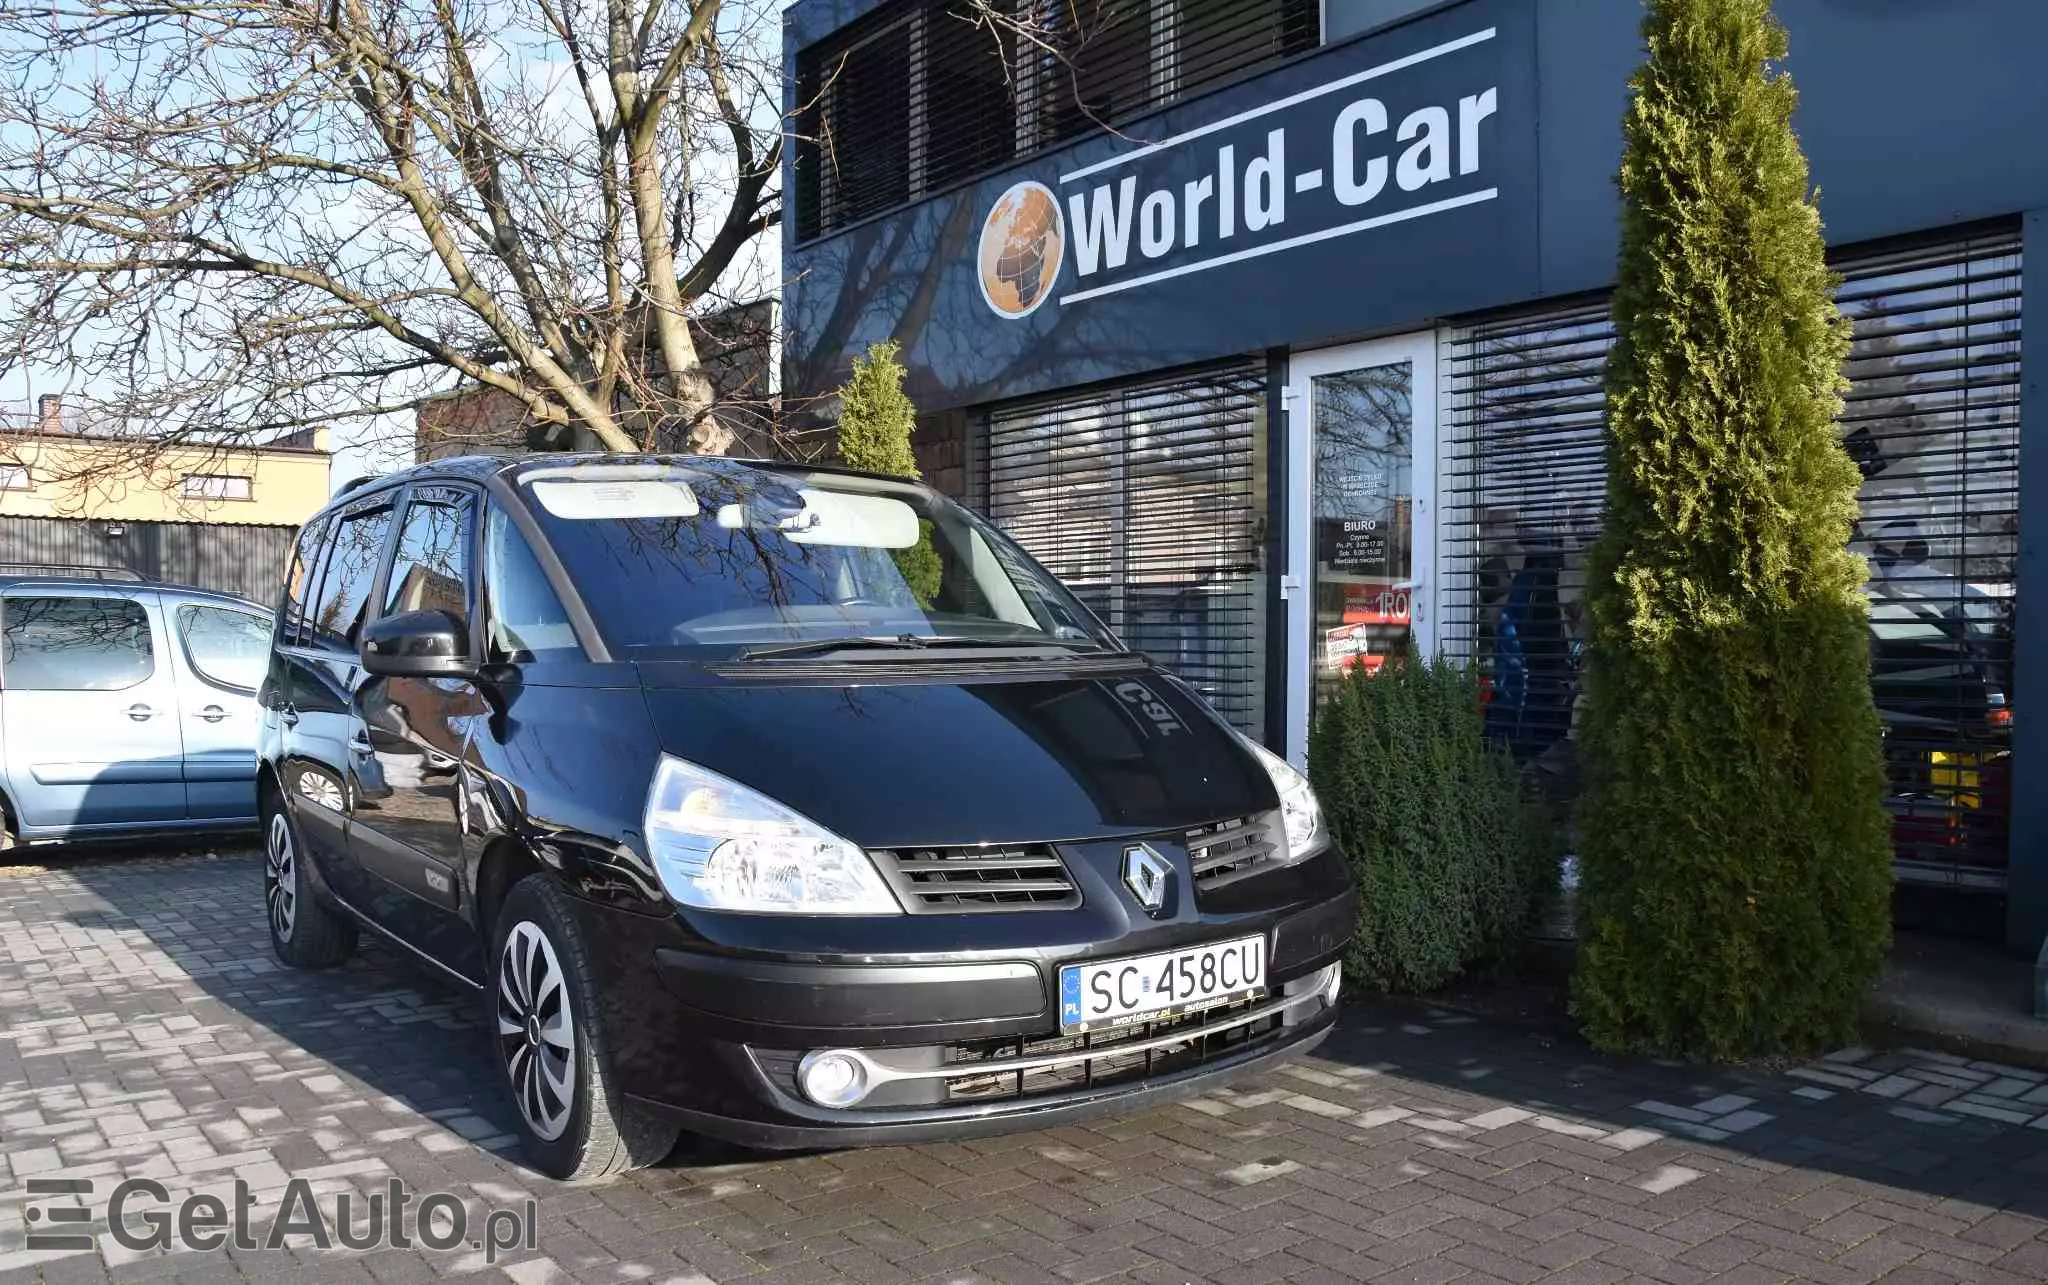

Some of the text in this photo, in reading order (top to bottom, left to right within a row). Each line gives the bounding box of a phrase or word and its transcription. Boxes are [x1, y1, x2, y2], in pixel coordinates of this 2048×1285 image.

[1068, 86, 1498, 277] World-Car
[1343, 520, 1376, 532] BIURO
[1065, 942, 1260, 1016] PL SC 458CU
[1112, 997, 1229, 1025] worldcar.pl autosalon
